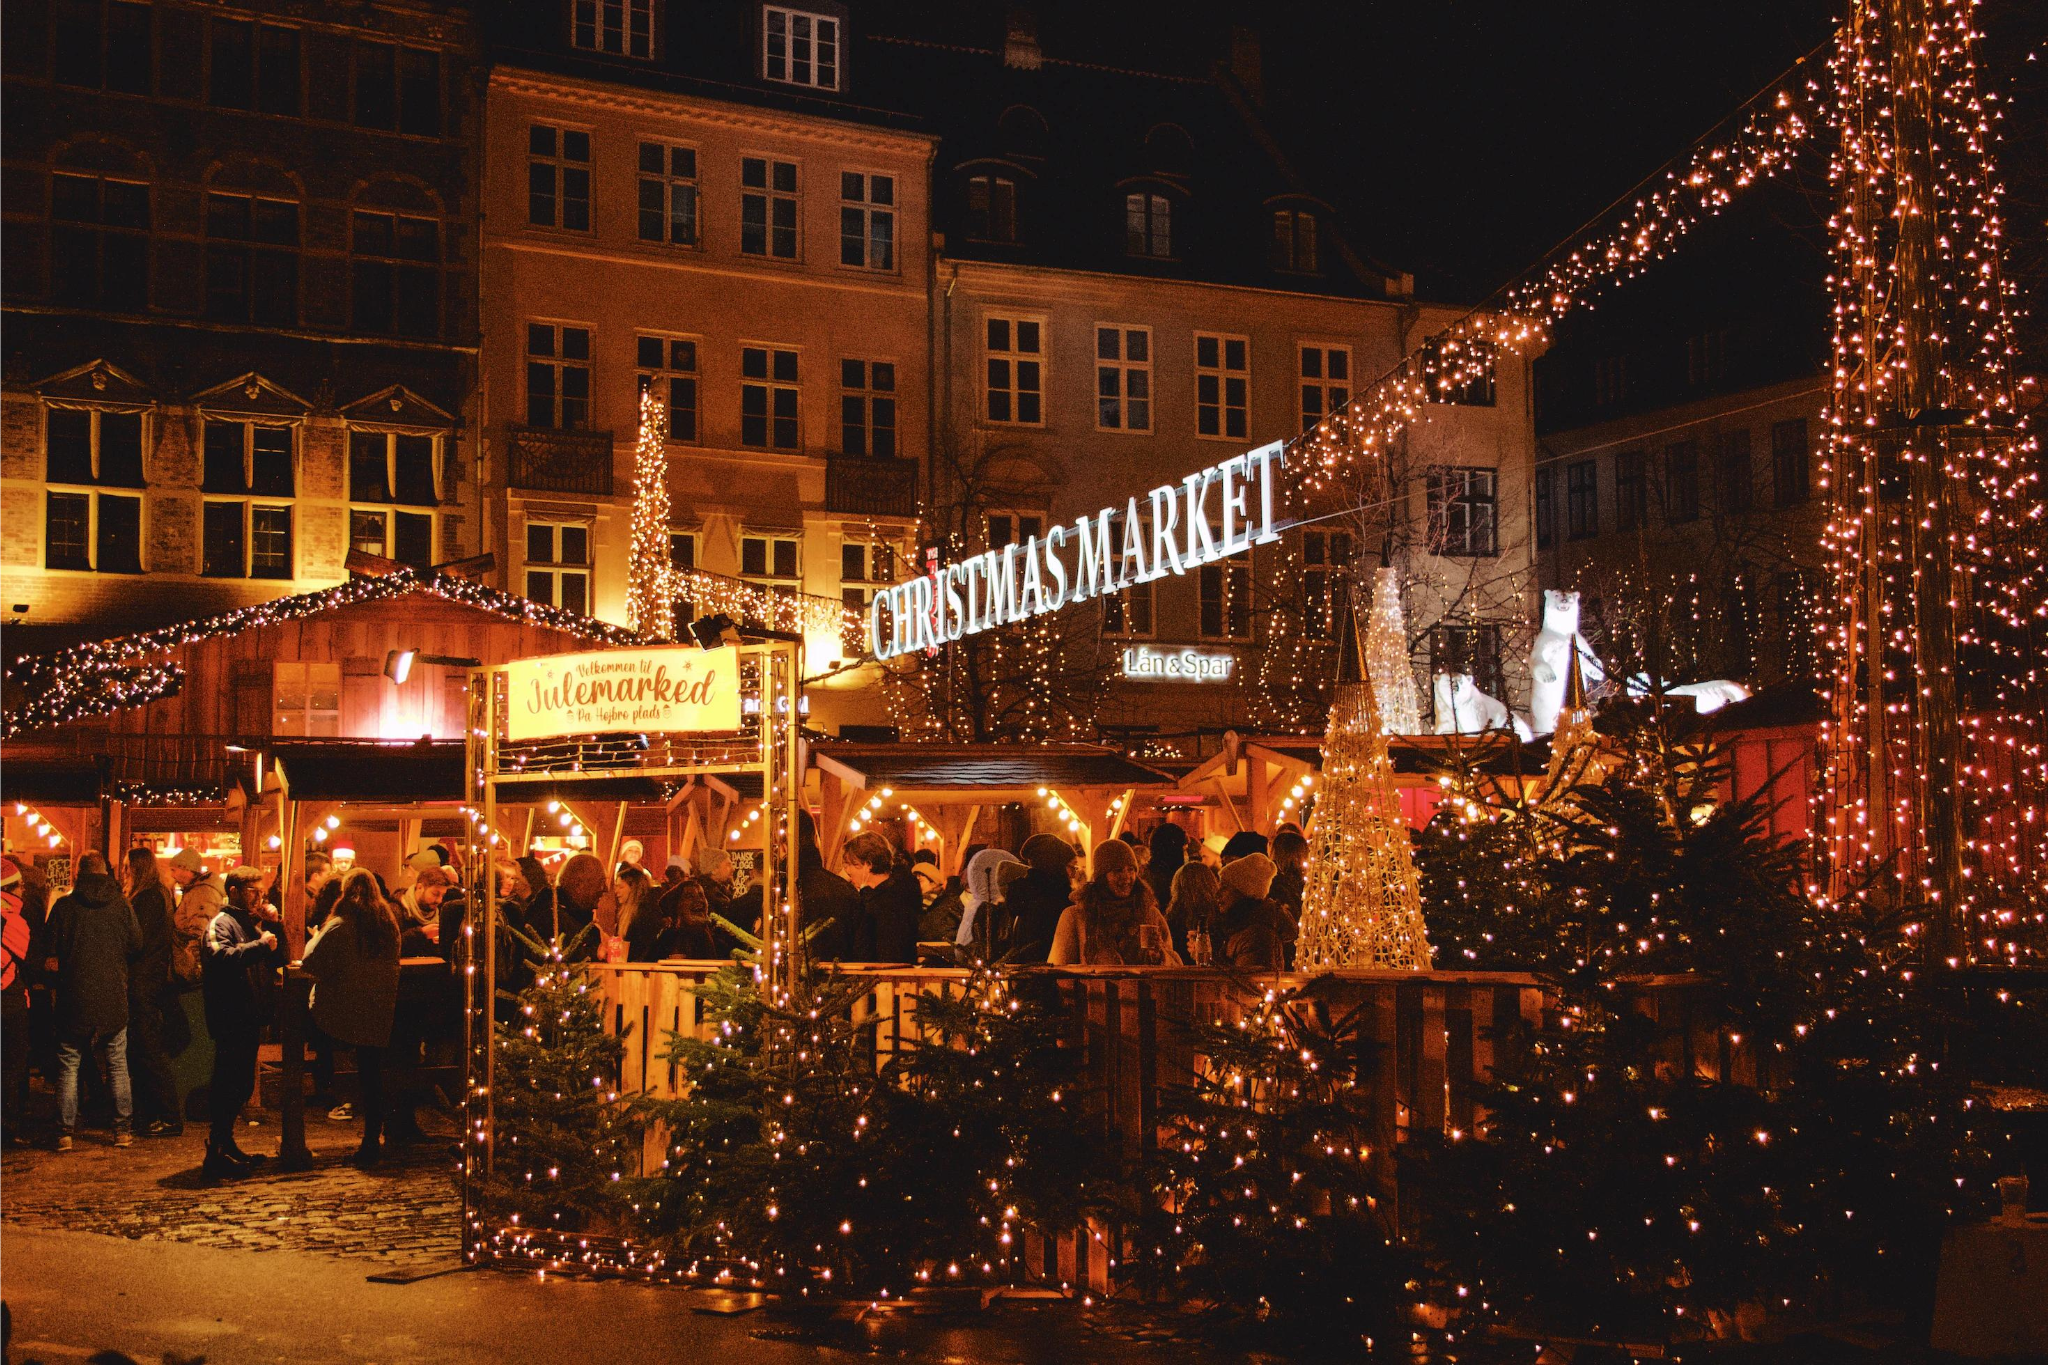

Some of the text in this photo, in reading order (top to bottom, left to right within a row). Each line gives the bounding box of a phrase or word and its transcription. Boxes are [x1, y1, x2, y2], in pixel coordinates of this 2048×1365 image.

[871, 524, 1068, 661] CHRISTMAS
[1072, 439, 1287, 603] MARKET
[576, 658, 652, 678] Velkommen til
[1127, 649, 1233, 679] Lån & Spar
[527, 664, 716, 714] Julemarked
[632, 703, 660, 725] plads
